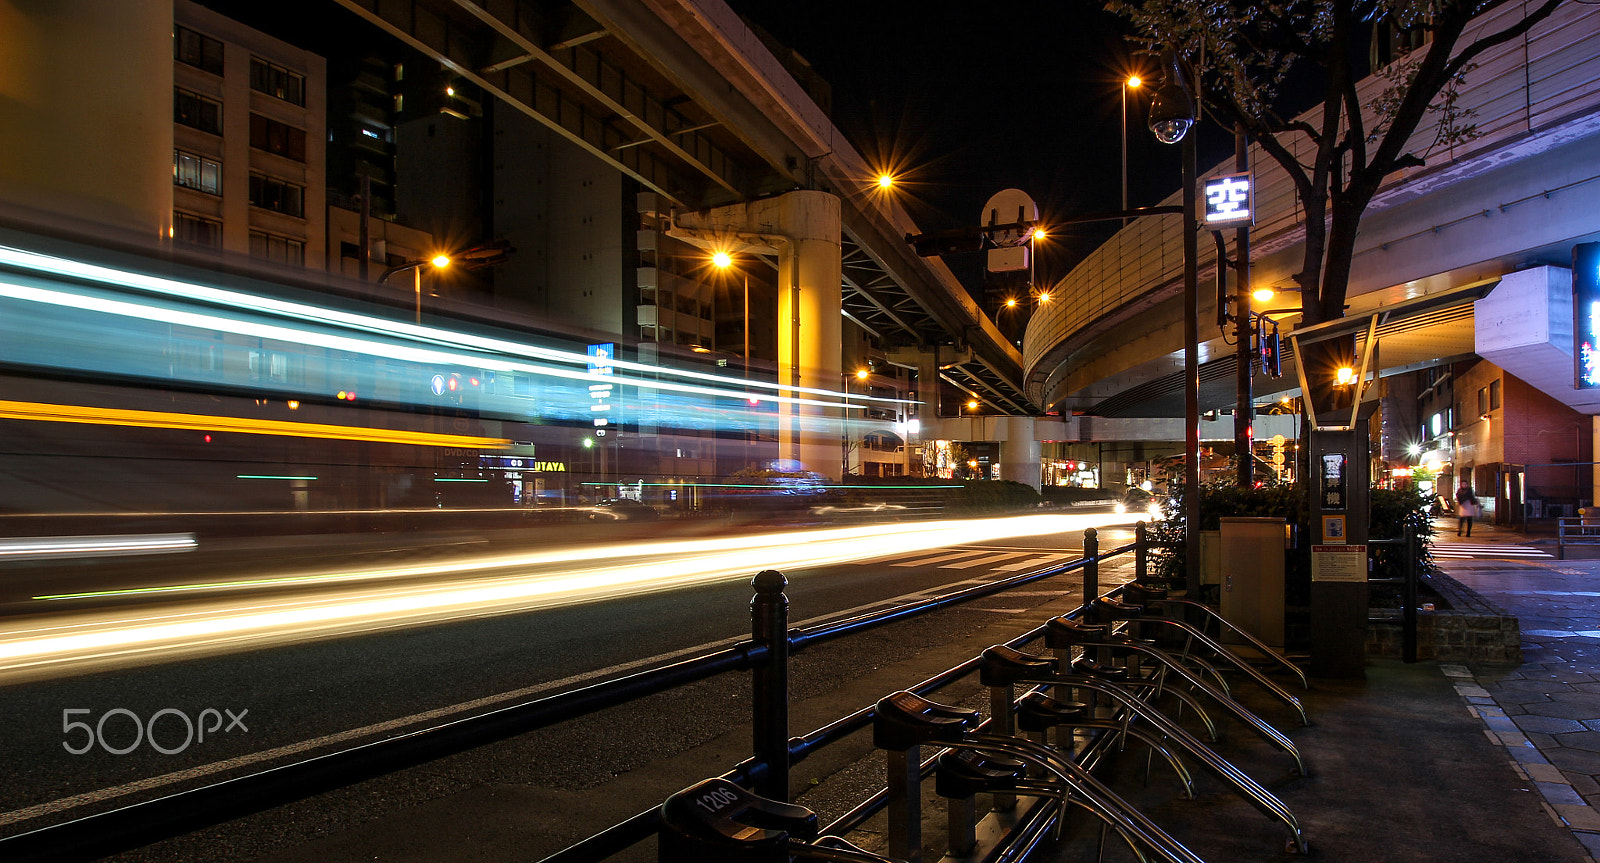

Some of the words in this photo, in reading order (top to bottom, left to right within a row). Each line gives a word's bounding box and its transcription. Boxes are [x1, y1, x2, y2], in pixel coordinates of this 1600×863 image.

[1206, 179, 1249, 221] 空
[444, 448, 478, 457] DVD/CD
[534, 461, 566, 472] UTAYA
[696, 787, 738, 813] 1206
